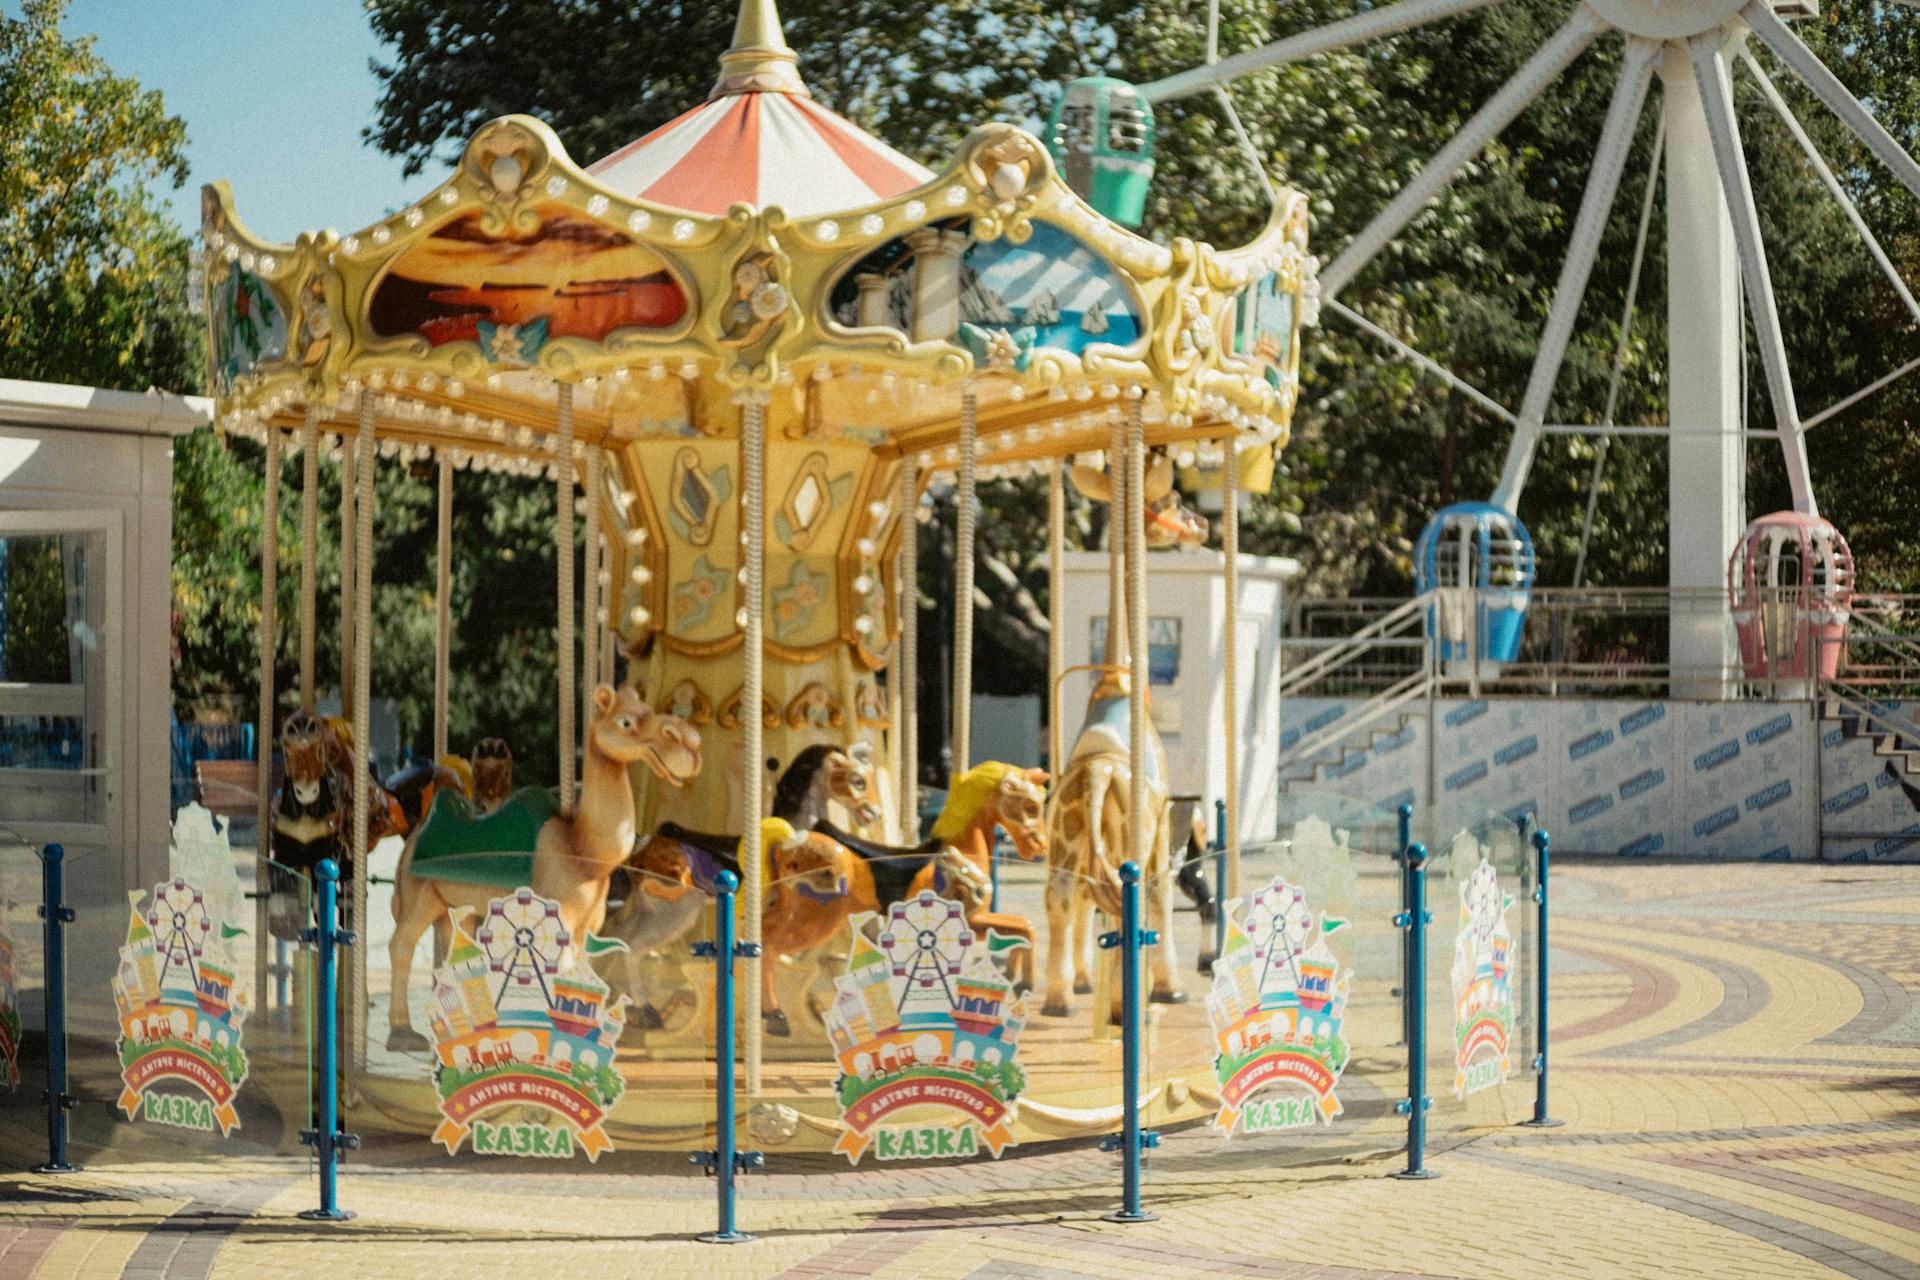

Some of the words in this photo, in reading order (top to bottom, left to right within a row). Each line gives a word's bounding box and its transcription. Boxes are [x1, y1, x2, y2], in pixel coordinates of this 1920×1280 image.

[146, 1092, 211, 1129] КАЗКА
[1245, 1096, 1314, 1131] КАЗКА
[475, 1123, 571, 1154] КАЗКА
[878, 1127, 975, 1157] КАЗКА
